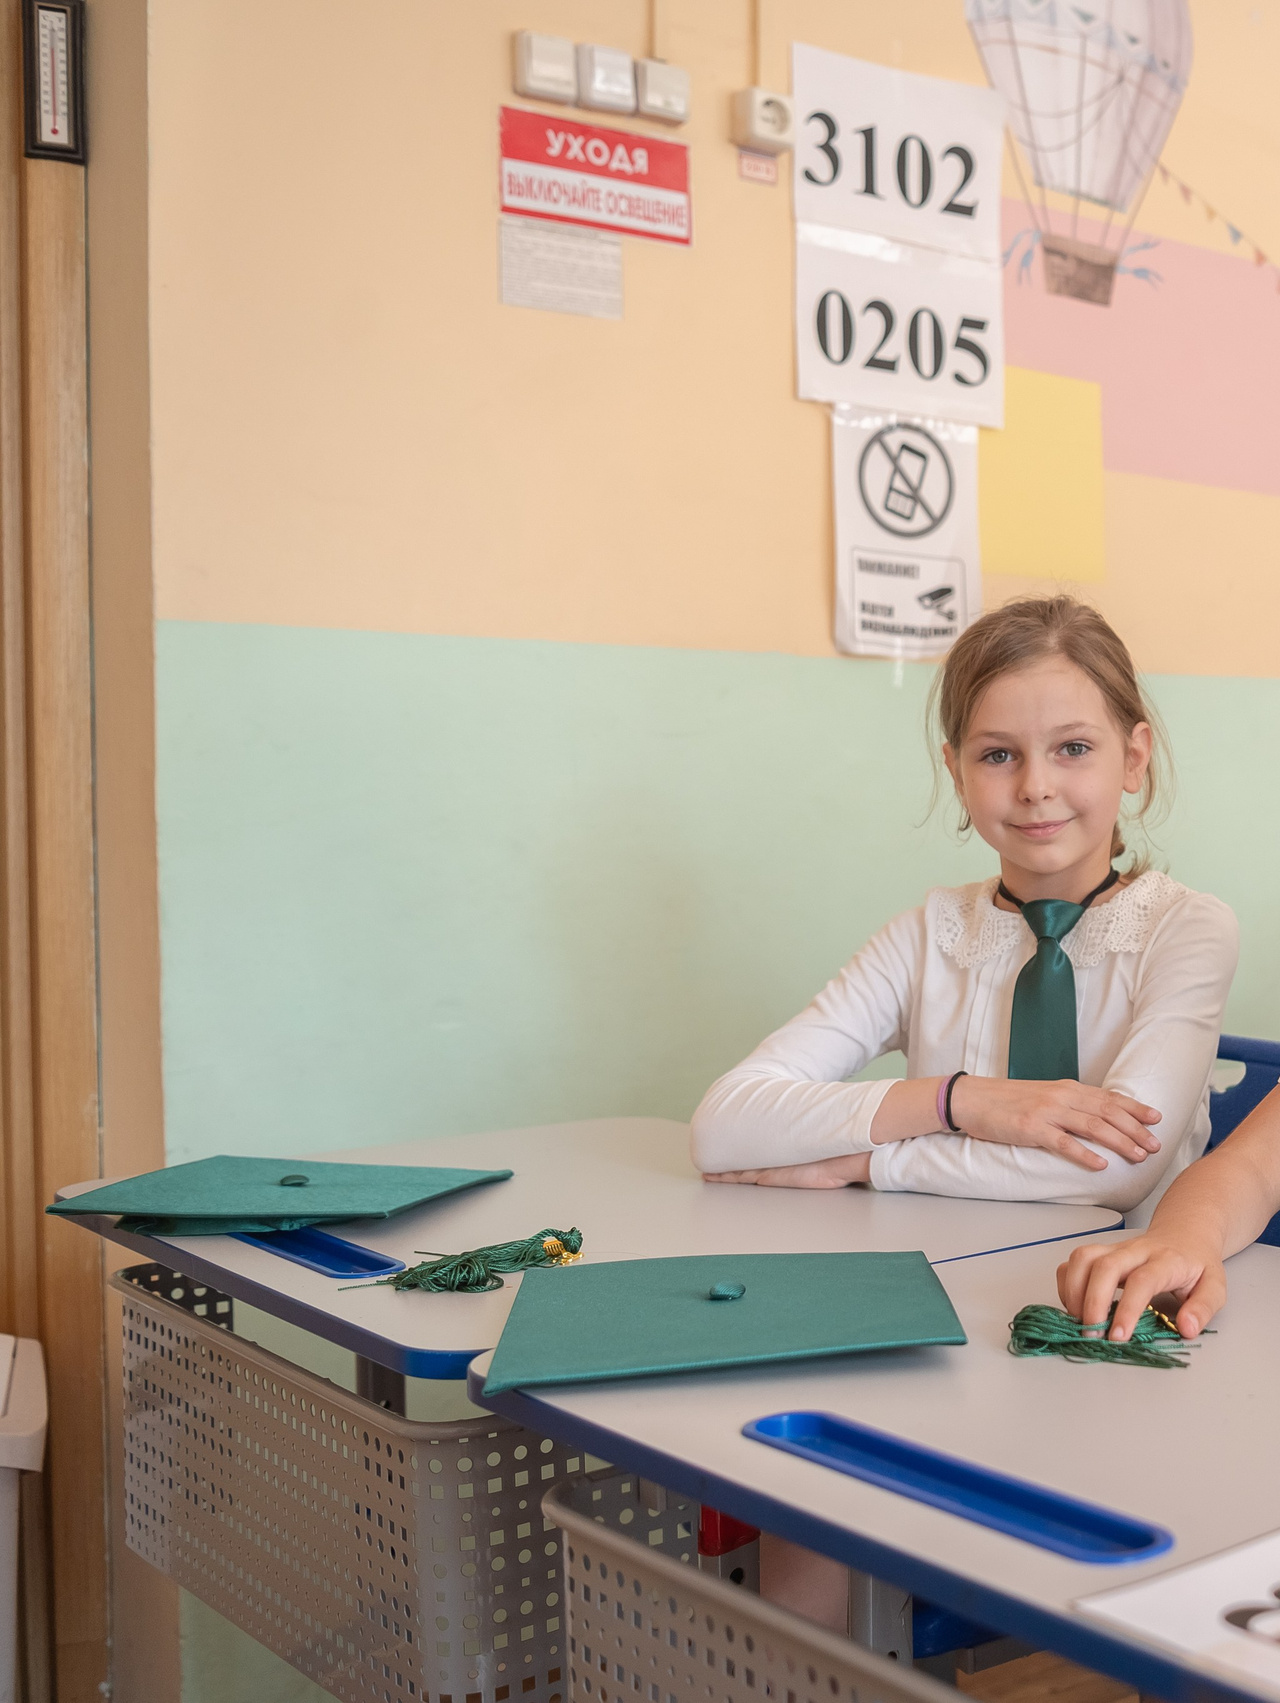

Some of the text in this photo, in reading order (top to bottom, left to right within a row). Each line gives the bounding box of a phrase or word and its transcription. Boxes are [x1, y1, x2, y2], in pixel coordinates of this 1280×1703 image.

[545, 128, 649, 175] УХОДЯ
[803, 111, 979, 220] 3102
[506, 172, 687, 228] ВЫКЛЮЧАЙТЕ ОСВЕЩЕНИЕ
[815, 289, 991, 387] 0205
